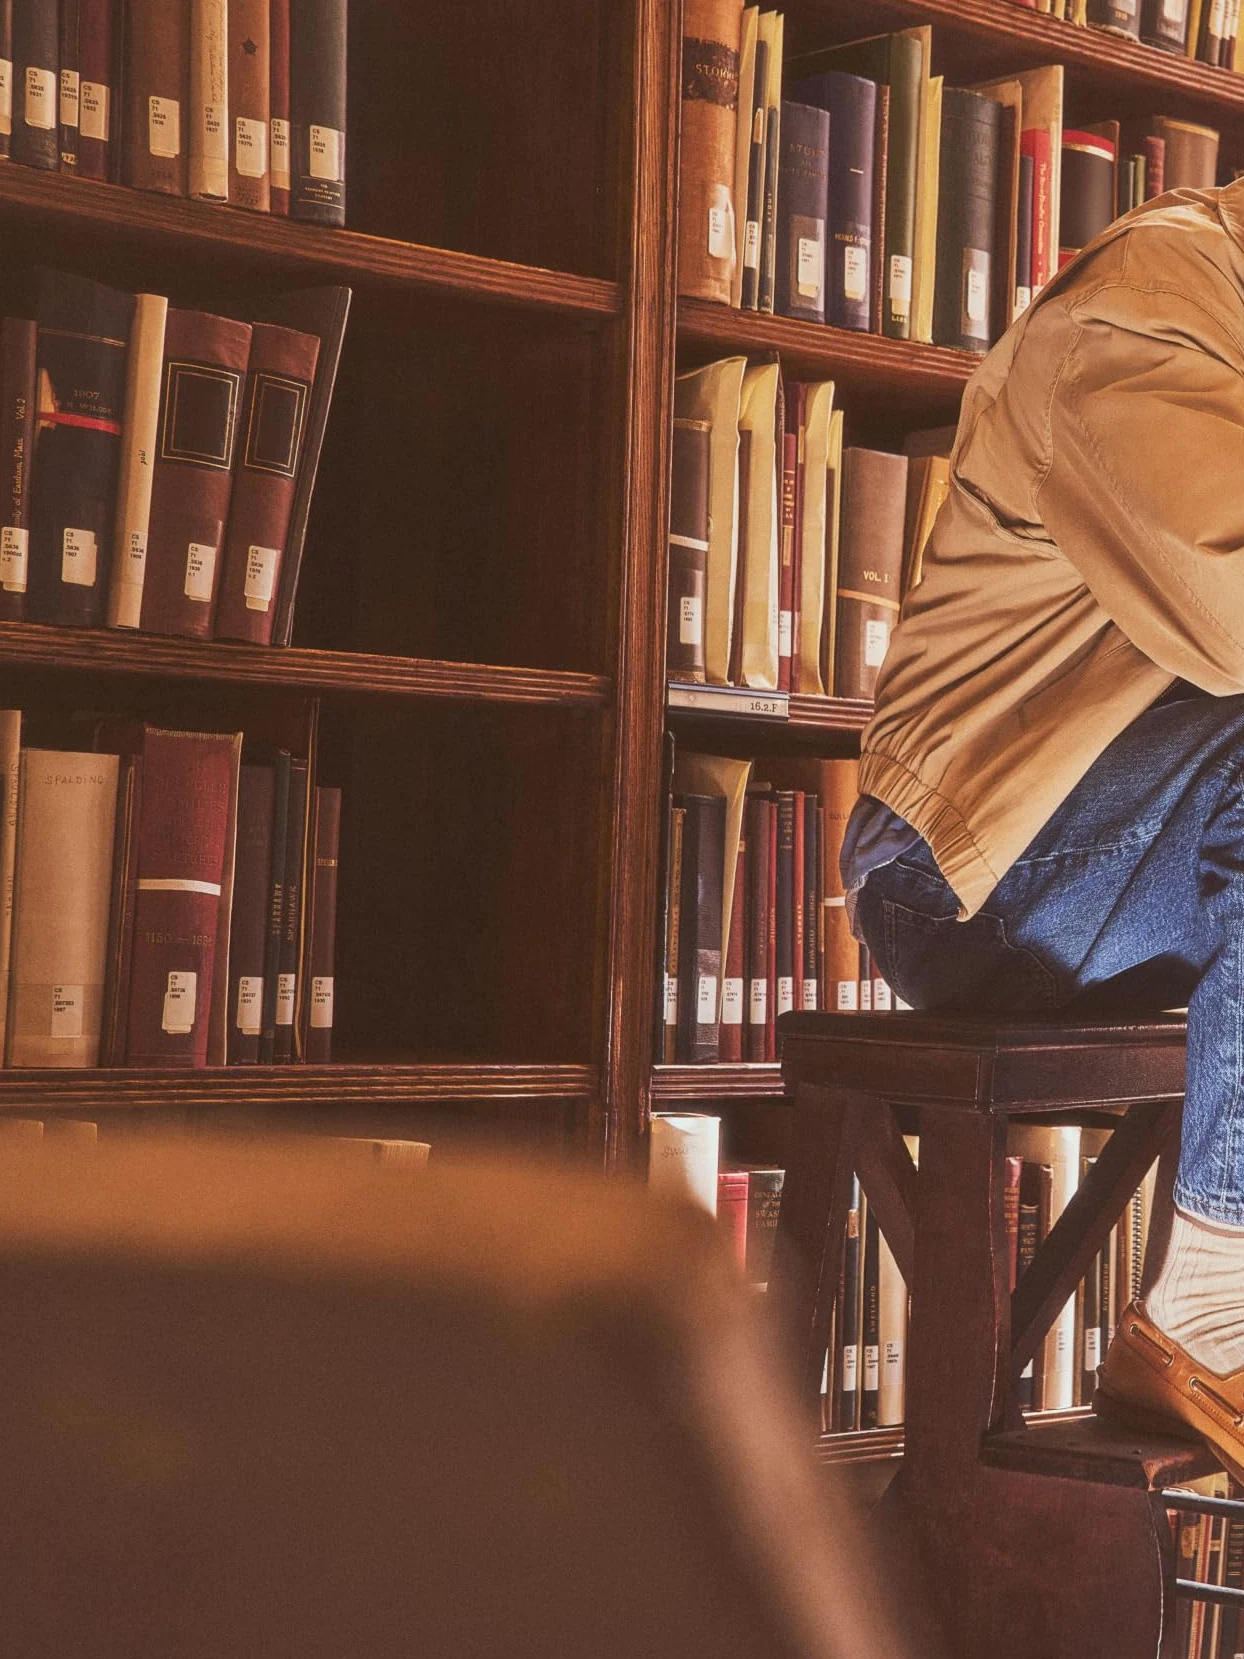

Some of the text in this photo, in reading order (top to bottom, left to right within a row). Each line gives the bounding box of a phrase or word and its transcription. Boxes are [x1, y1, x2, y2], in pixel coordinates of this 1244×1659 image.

[12, 497, 21, 506] of
[750, 702, 778, 713] 16.2.F
[44, 775, 104, 785] SPALDING
[754, 1191, 782, 1199] GENEAL
[755, 1209, 780, 1218] SWAS
